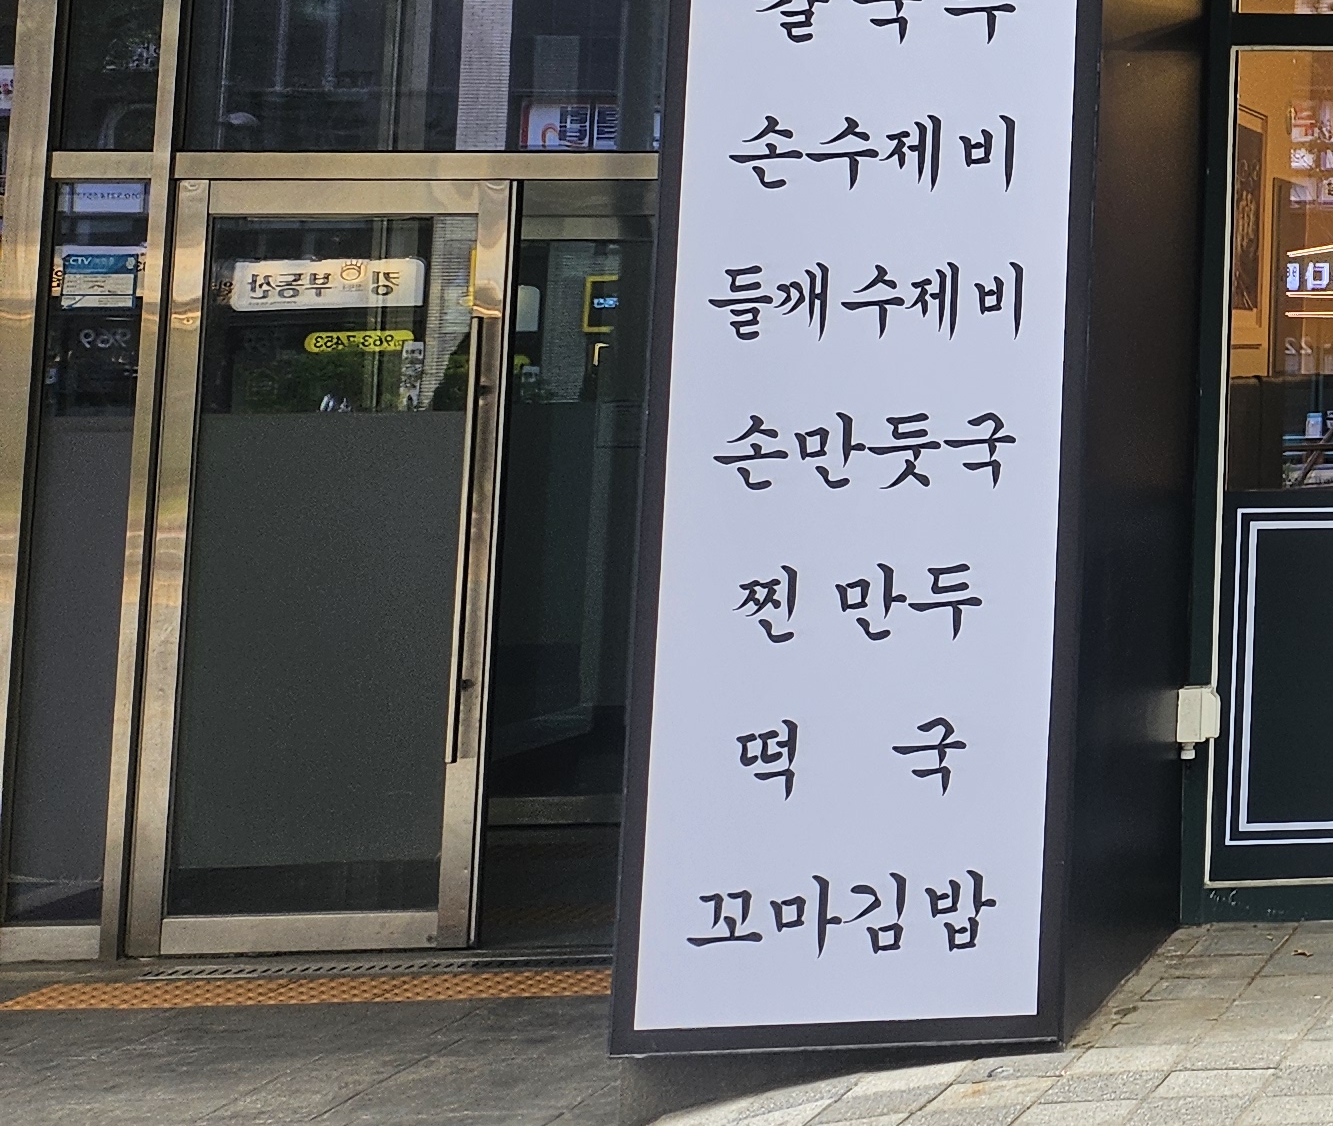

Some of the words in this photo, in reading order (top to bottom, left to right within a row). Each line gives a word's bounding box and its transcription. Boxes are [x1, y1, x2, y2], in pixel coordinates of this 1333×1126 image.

[728, 114, 1016, 193] 손수제비
[712, 411, 1017, 491] 손만둣국
[686, 869, 997, 959] 꼬마김밥
